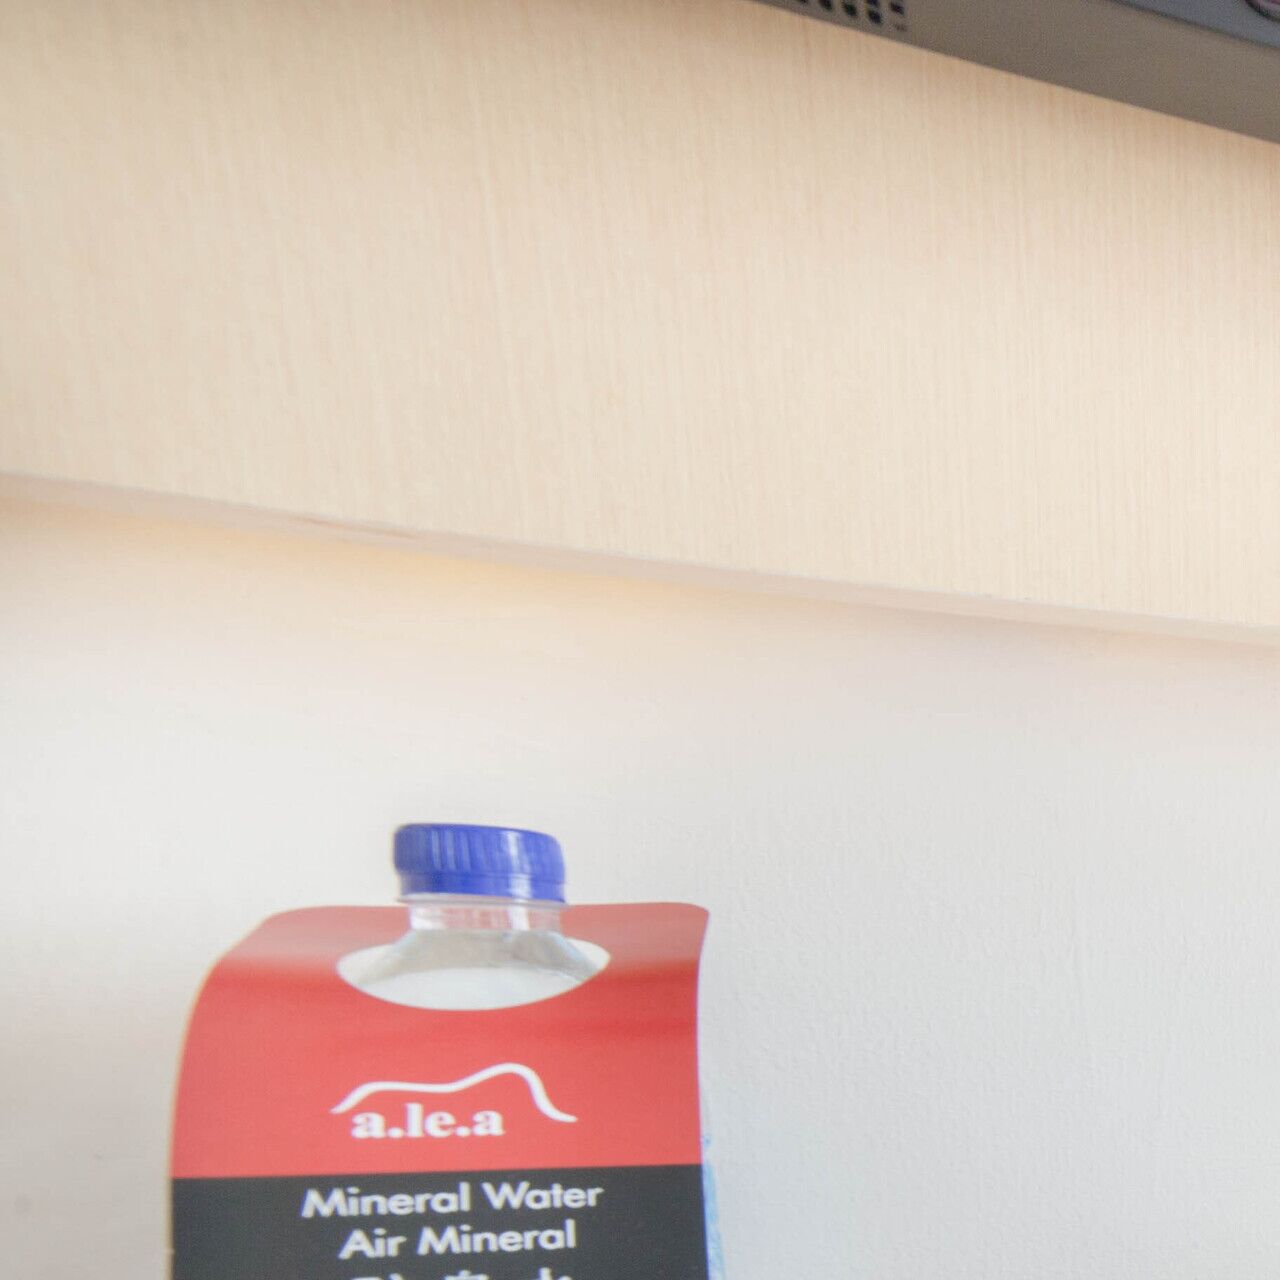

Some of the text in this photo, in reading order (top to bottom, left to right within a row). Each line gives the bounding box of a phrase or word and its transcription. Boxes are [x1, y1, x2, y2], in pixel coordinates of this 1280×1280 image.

[301, 1181, 604, 1218] Mineral Water
[338, 1219, 577, 1259] Air Mineral
